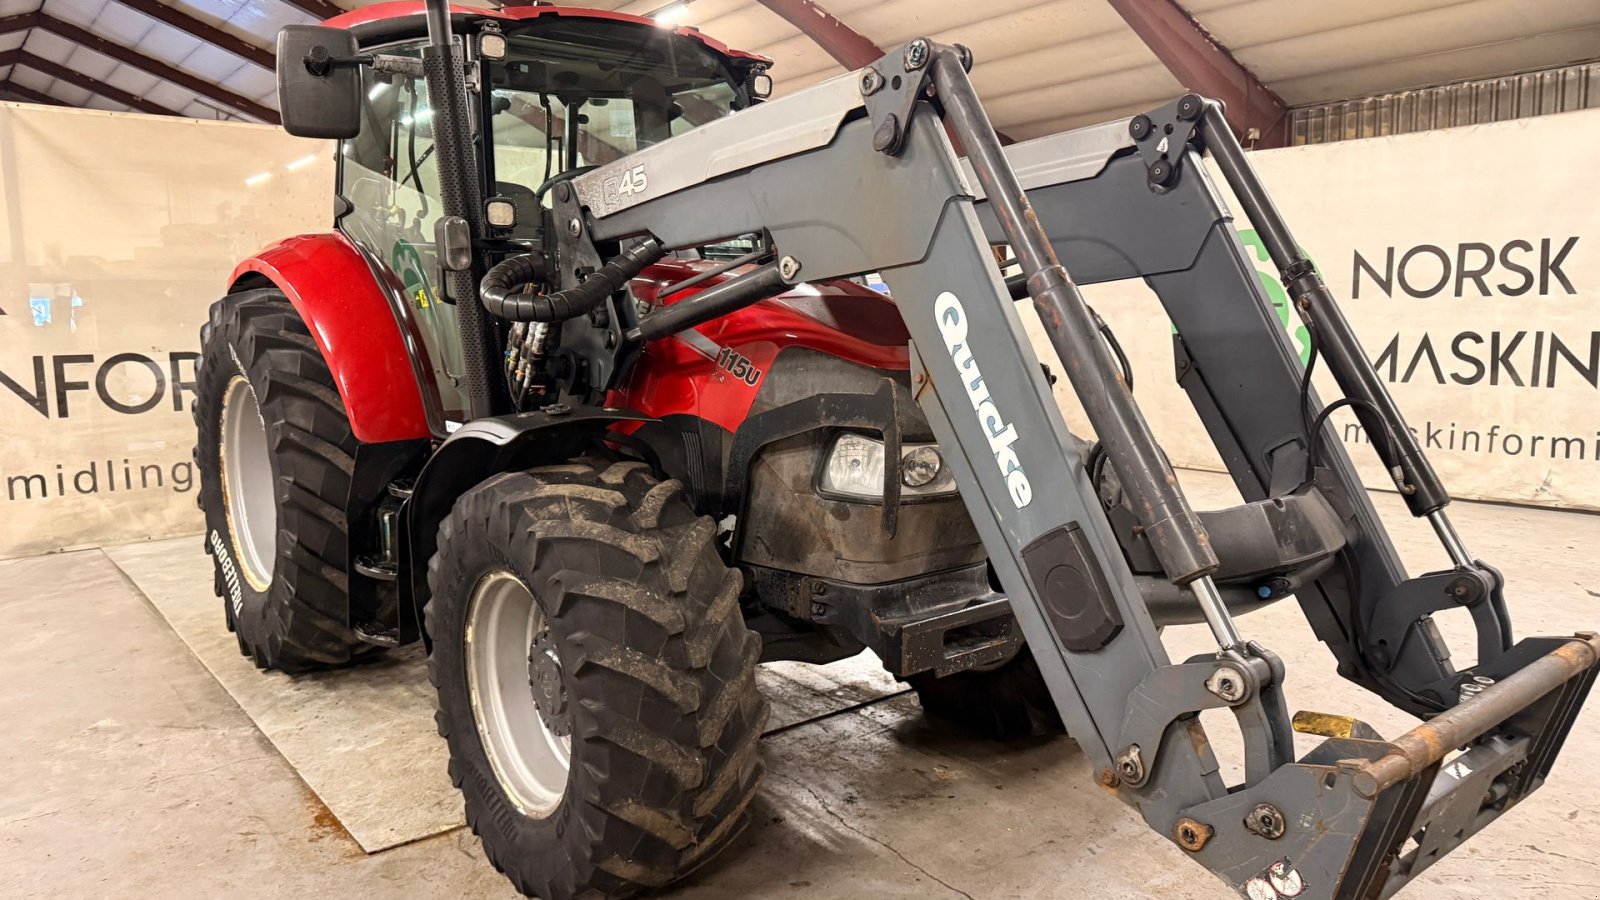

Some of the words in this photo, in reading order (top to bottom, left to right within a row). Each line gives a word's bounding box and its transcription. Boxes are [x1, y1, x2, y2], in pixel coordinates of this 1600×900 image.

[603, 162, 648, 205] Q45
[1351, 236, 1580, 299] NORSK
[718, 346, 763, 386] 115U
[934, 291, 1033, 509] Quicke
[7, 459, 194, 500] midling
[210, 529, 243, 619] TRELLEBORG
